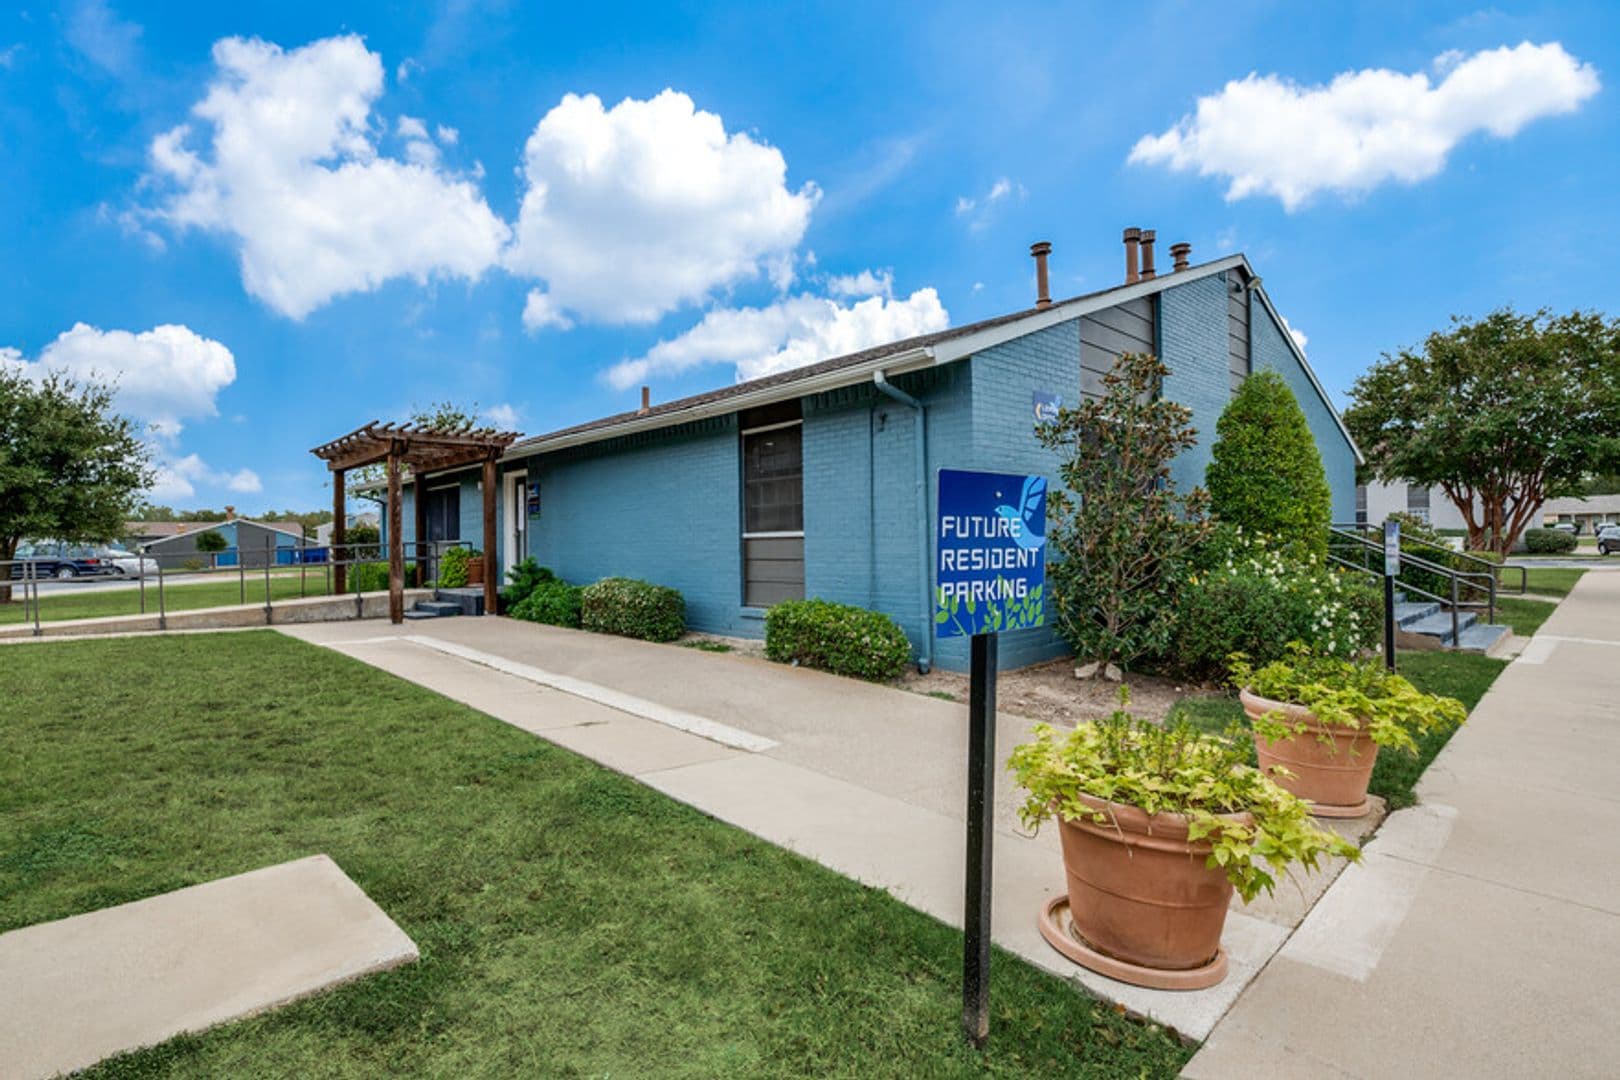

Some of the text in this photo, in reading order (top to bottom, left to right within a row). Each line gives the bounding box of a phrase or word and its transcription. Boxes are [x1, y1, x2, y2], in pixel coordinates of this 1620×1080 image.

[942, 516, 1021, 538] FUTURE
[941, 547, 1039, 571] RESIDENT
[941, 578, 1027, 604] PARKING
